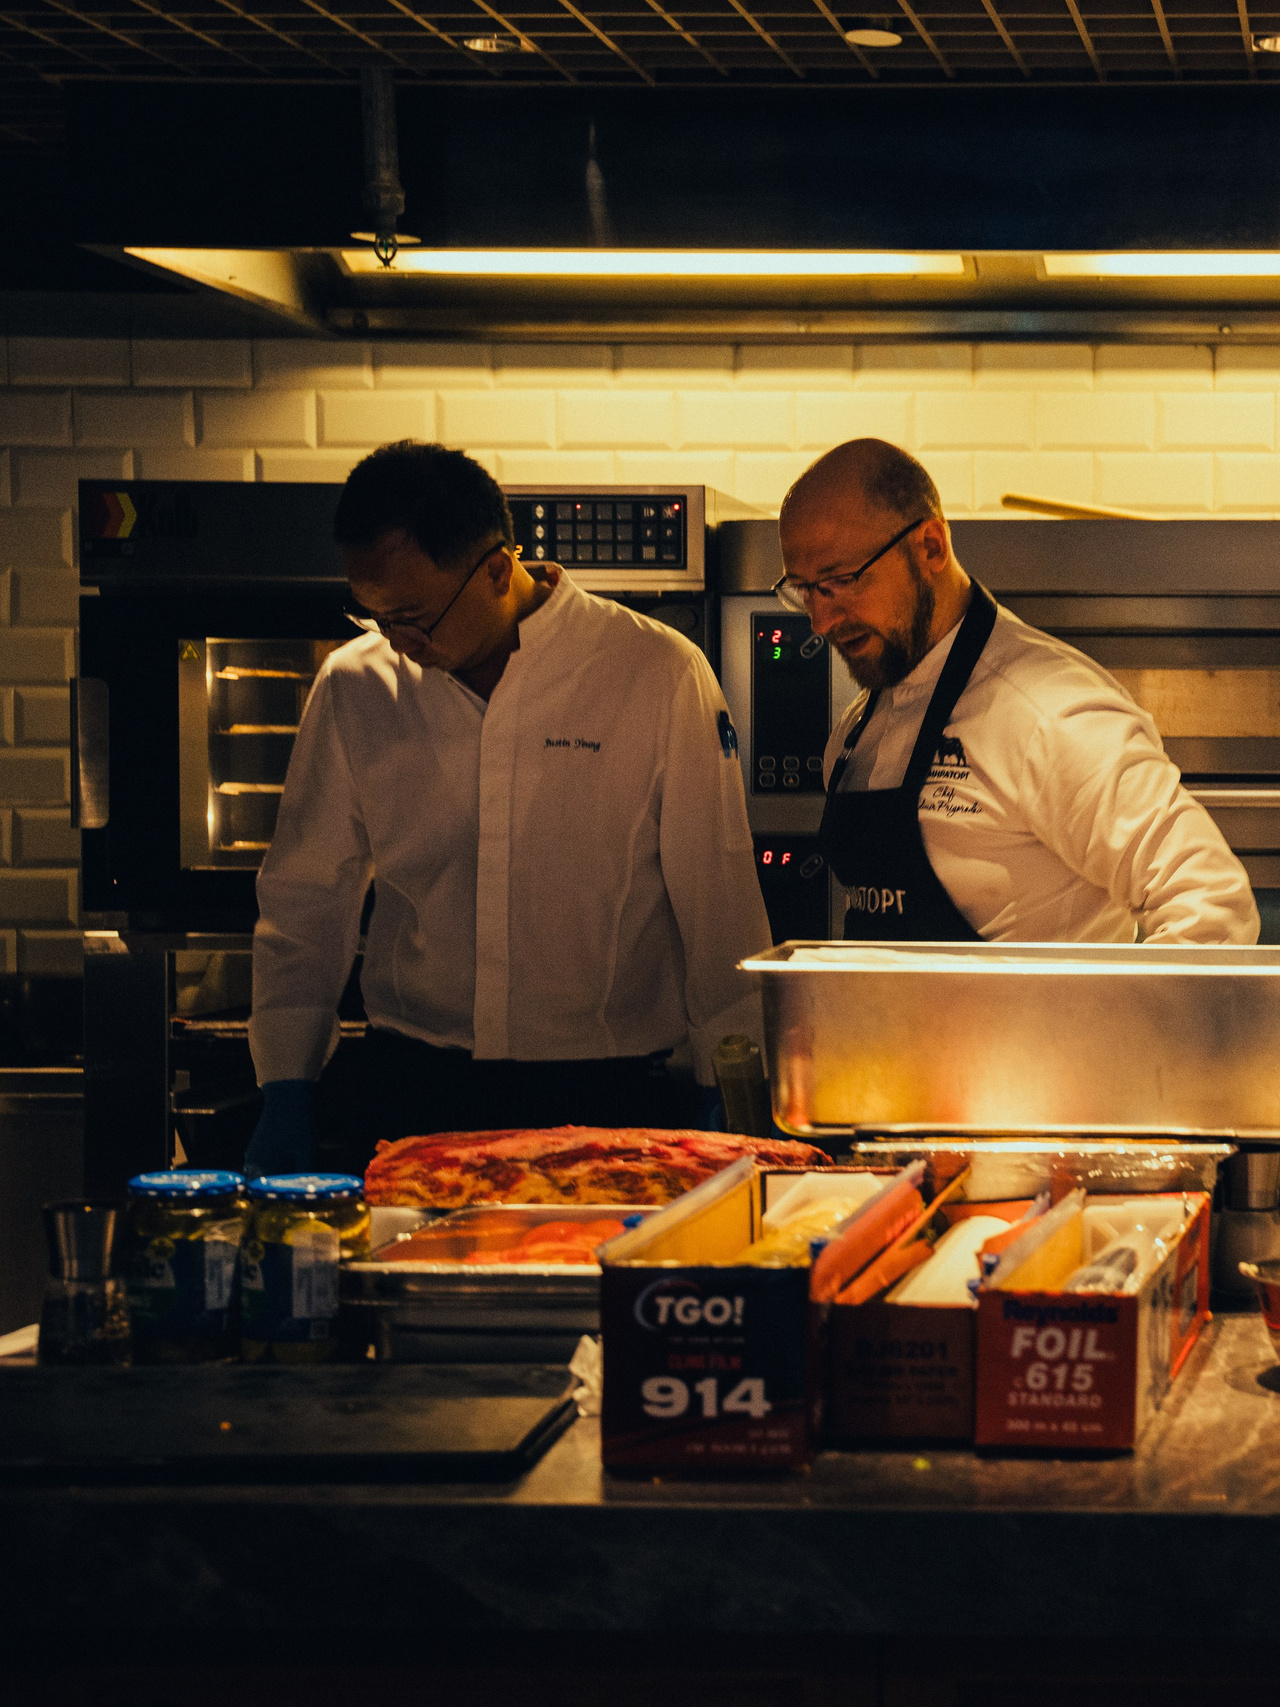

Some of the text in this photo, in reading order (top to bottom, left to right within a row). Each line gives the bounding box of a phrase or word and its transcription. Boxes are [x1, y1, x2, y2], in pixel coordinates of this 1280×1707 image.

[771, 629, 783, 644] 2
[772, 646, 782, 660] 3
[653, 1295, 746, 1327] TGO!
[1003, 1300, 1118, 1326] Reynolds
[1011, 1326, 1108, 1361] FOIL
[1025, 1361, 1095, 1392] 615
[641, 1375, 773, 1419] 914
[1007, 1390, 1104, 1409] STANDARD
